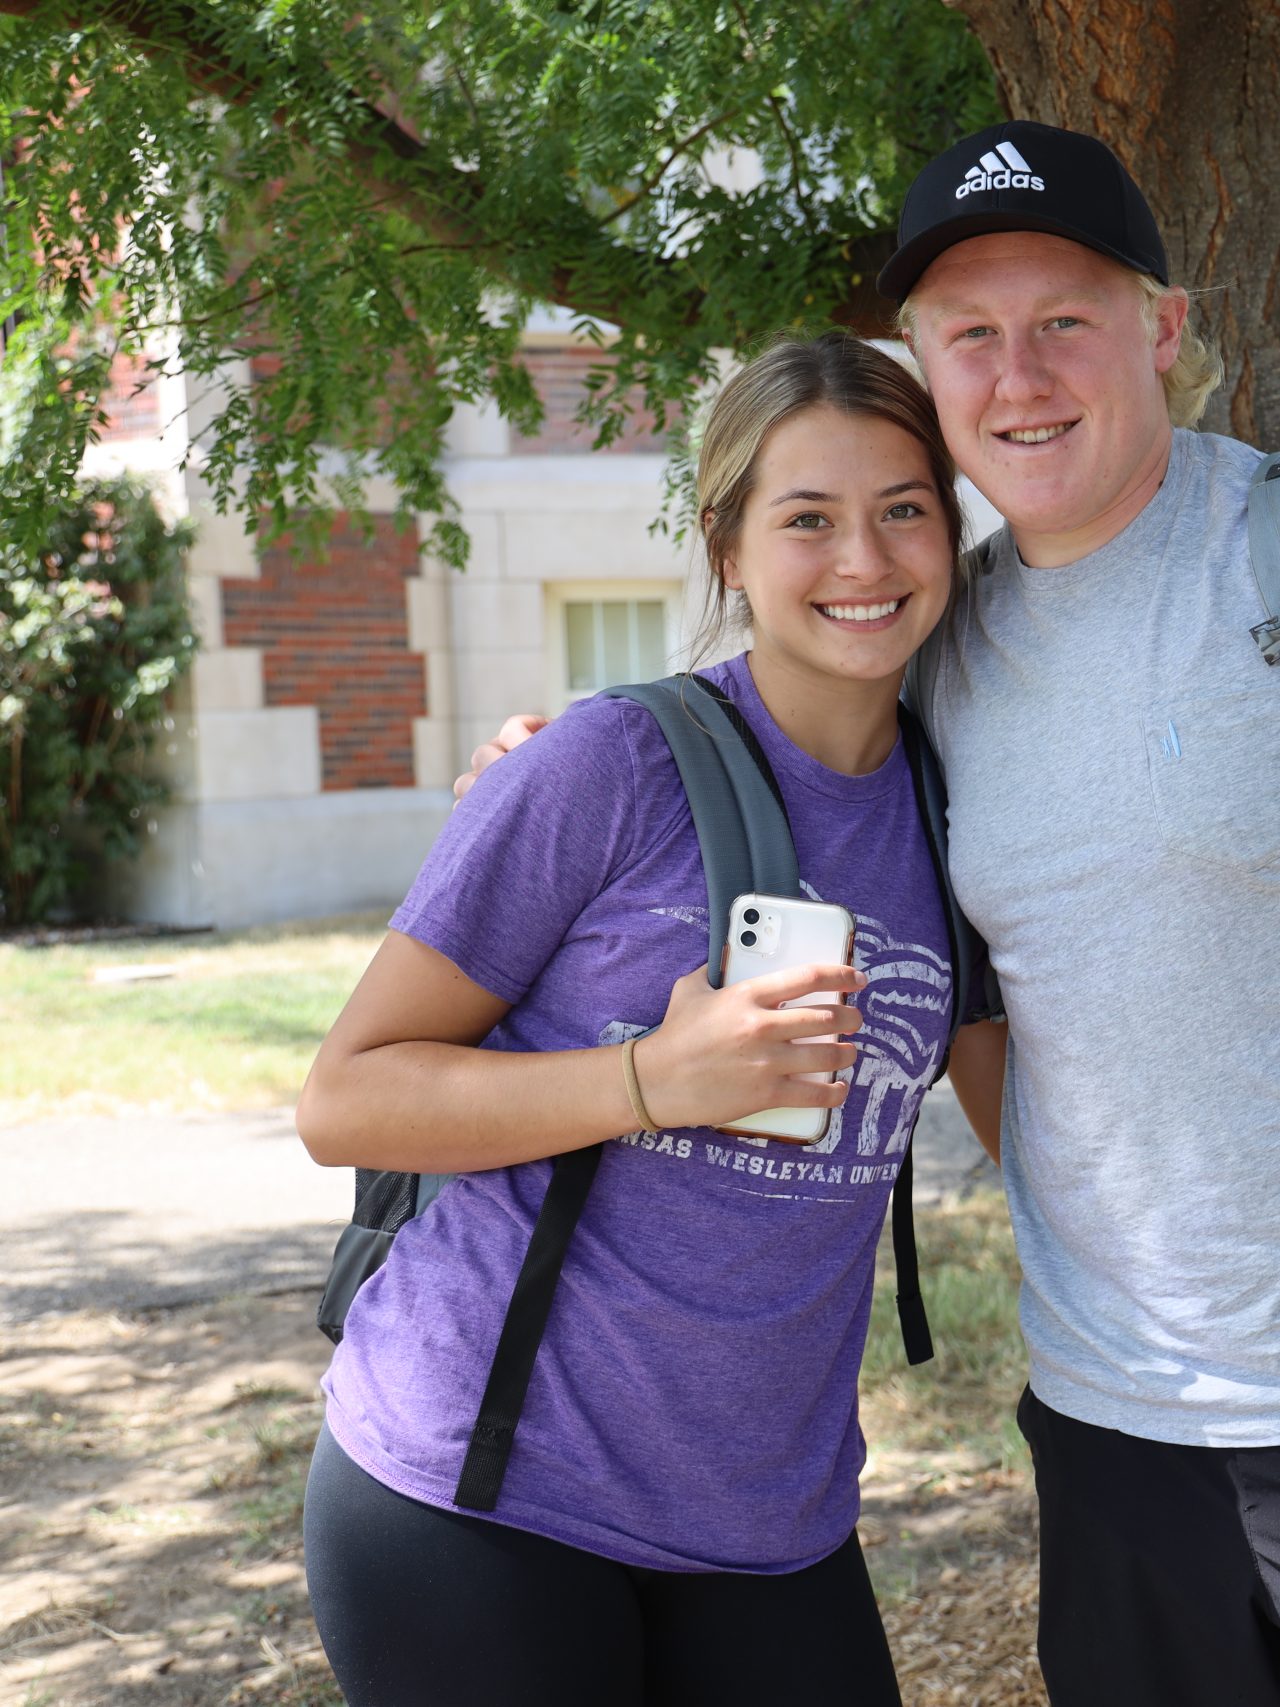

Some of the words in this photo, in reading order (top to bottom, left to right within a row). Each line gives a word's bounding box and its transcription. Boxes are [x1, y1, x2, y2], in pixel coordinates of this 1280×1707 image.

[955, 169, 1046, 200] adidas
[614, 1131, 693, 1159] NSAS
[705, 1143, 843, 1184] WESLEYAN
